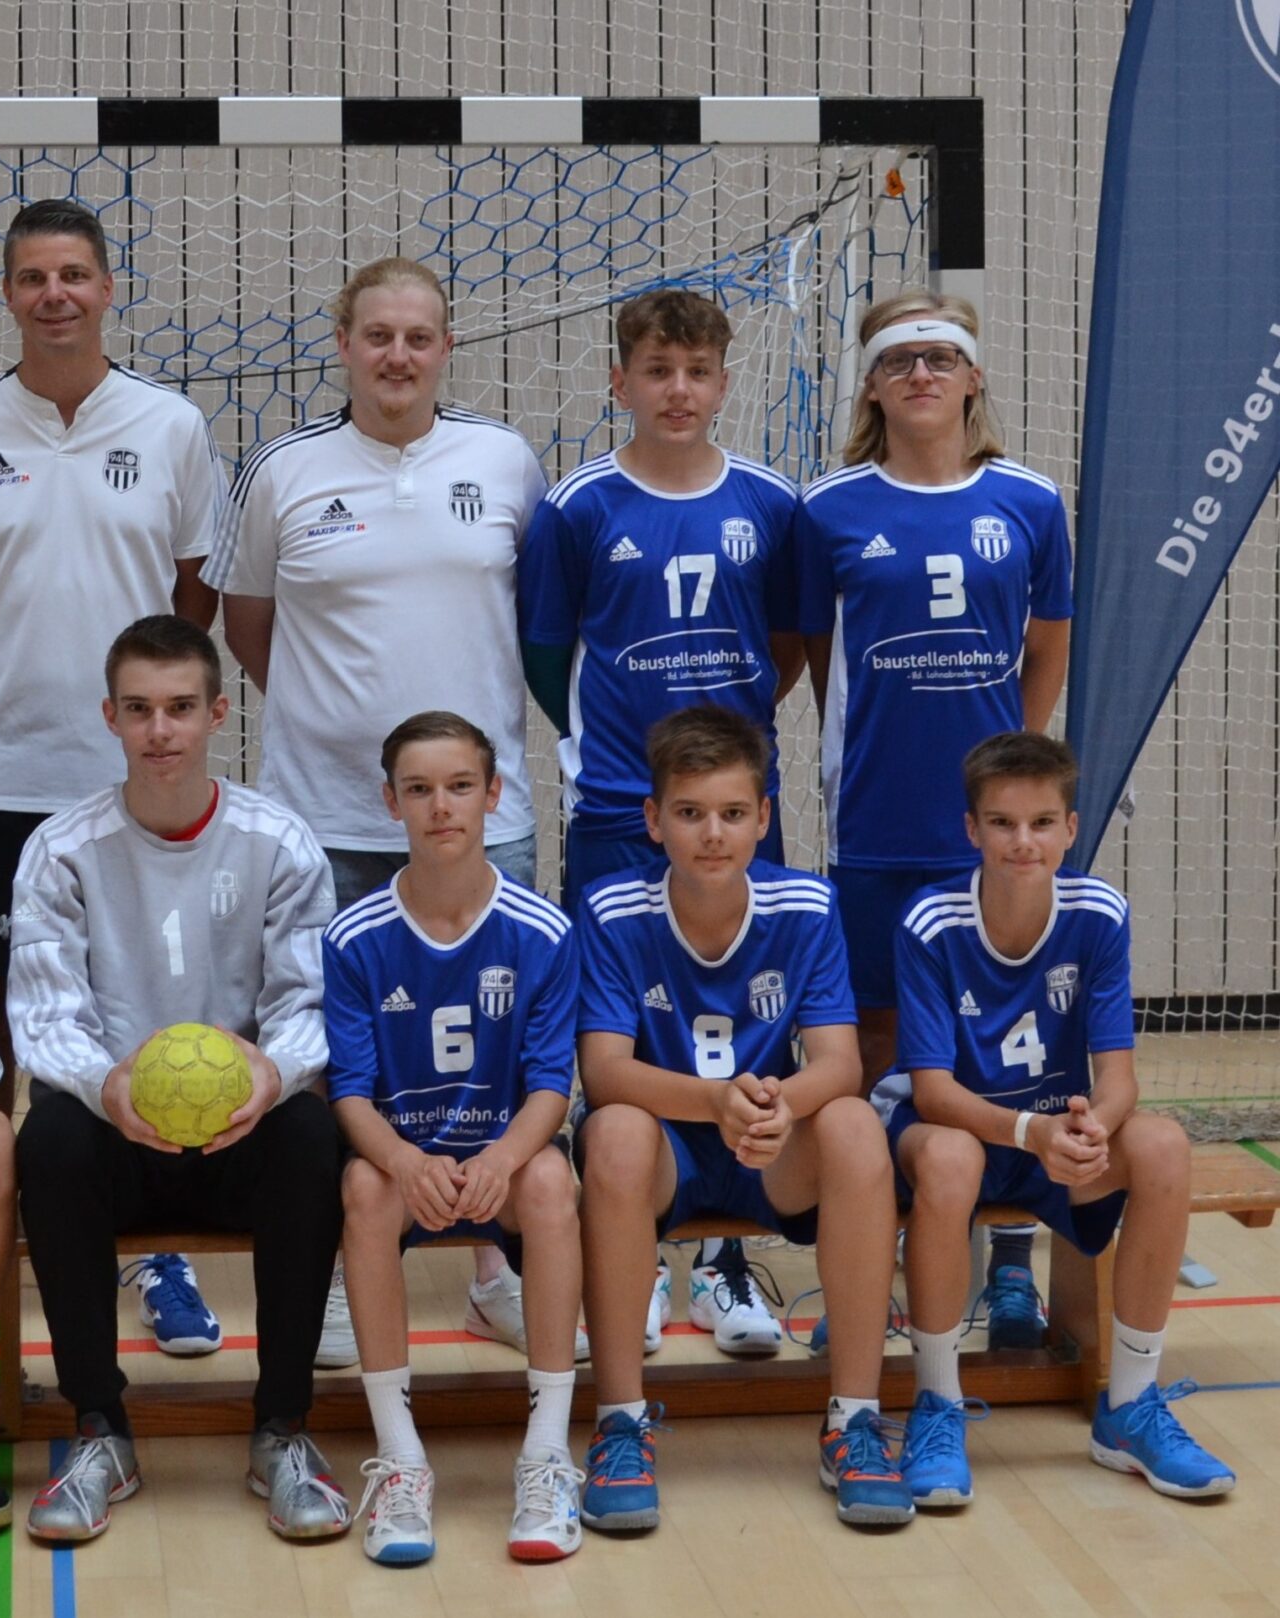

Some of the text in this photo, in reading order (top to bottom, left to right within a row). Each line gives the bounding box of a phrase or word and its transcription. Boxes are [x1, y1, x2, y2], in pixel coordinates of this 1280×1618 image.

[109, 453, 122, 463] 94
[453, 486, 466, 496] 94
[320, 510, 353, 521] adidas
[726, 524, 738, 534] 94
[1155, 495, 1222, 577] Die
[609, 550, 643, 562] adidas
[861, 548, 896, 559] adidas
[664, 554, 716, 618] 17
[926, 554, 966, 619] 3
[162, 909, 185, 976] 1
[483, 973, 496, 984] 94
[380, 1002, 416, 1012] adidas
[431, 1005, 475, 1074] 6
[1000, 1010, 1046, 1077] 4
[692, 1014, 735, 1079] 8
